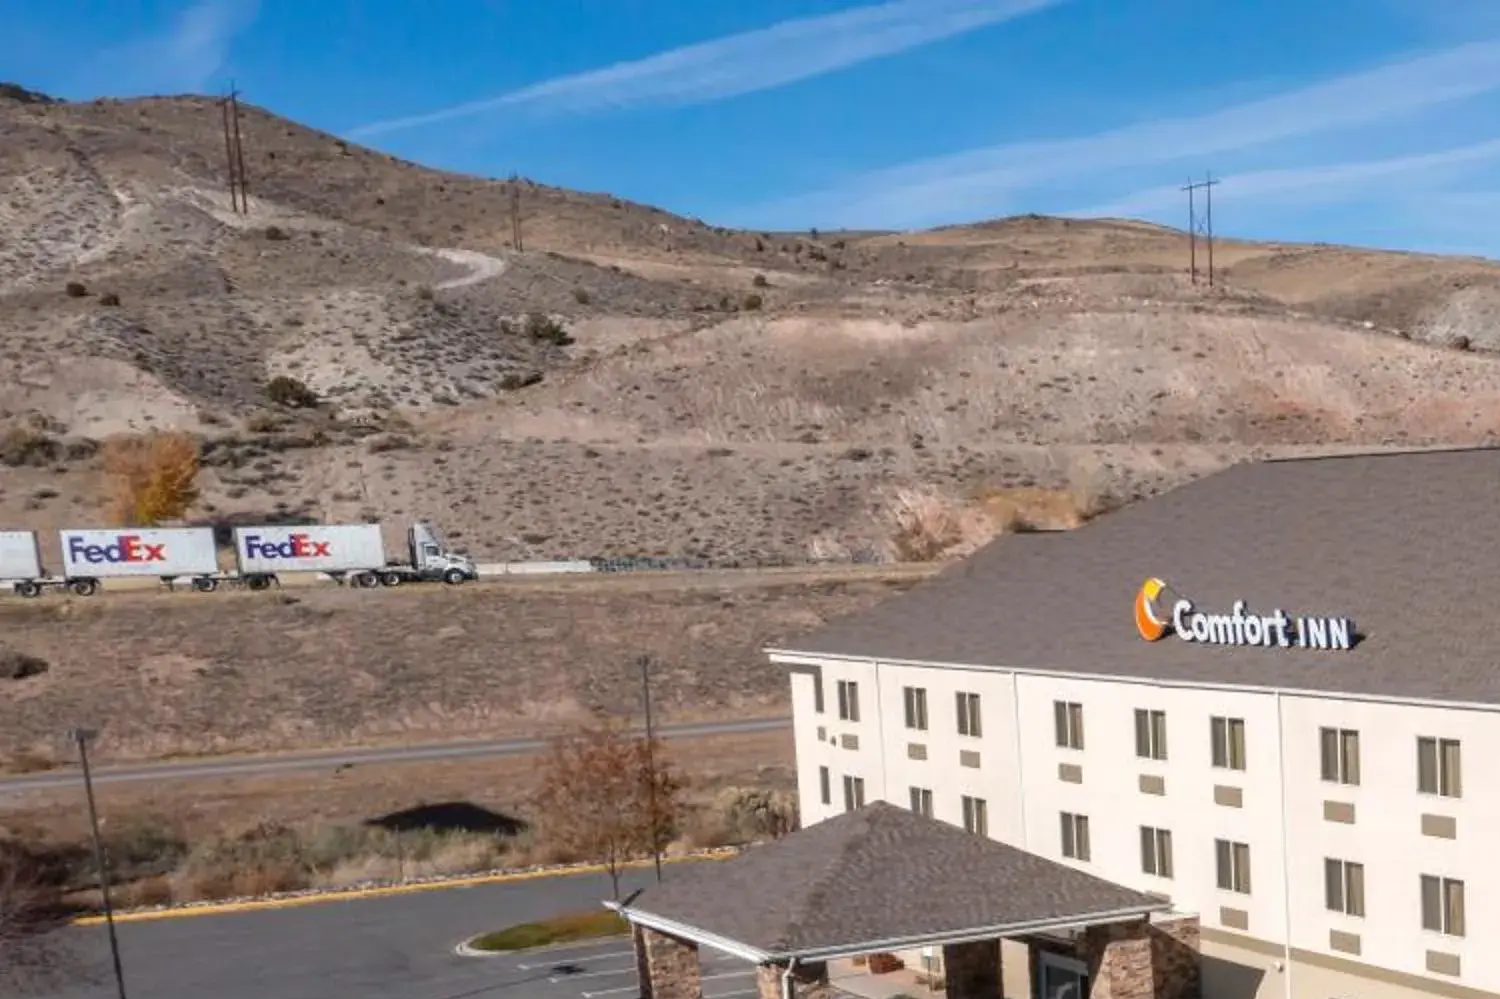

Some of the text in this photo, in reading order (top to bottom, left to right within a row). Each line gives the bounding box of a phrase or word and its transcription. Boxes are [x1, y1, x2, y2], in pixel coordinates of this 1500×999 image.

[68, 534, 166, 563] FedEx
[244, 533, 332, 559] FedEx
[1172, 599, 1350, 650] Comfort INN
